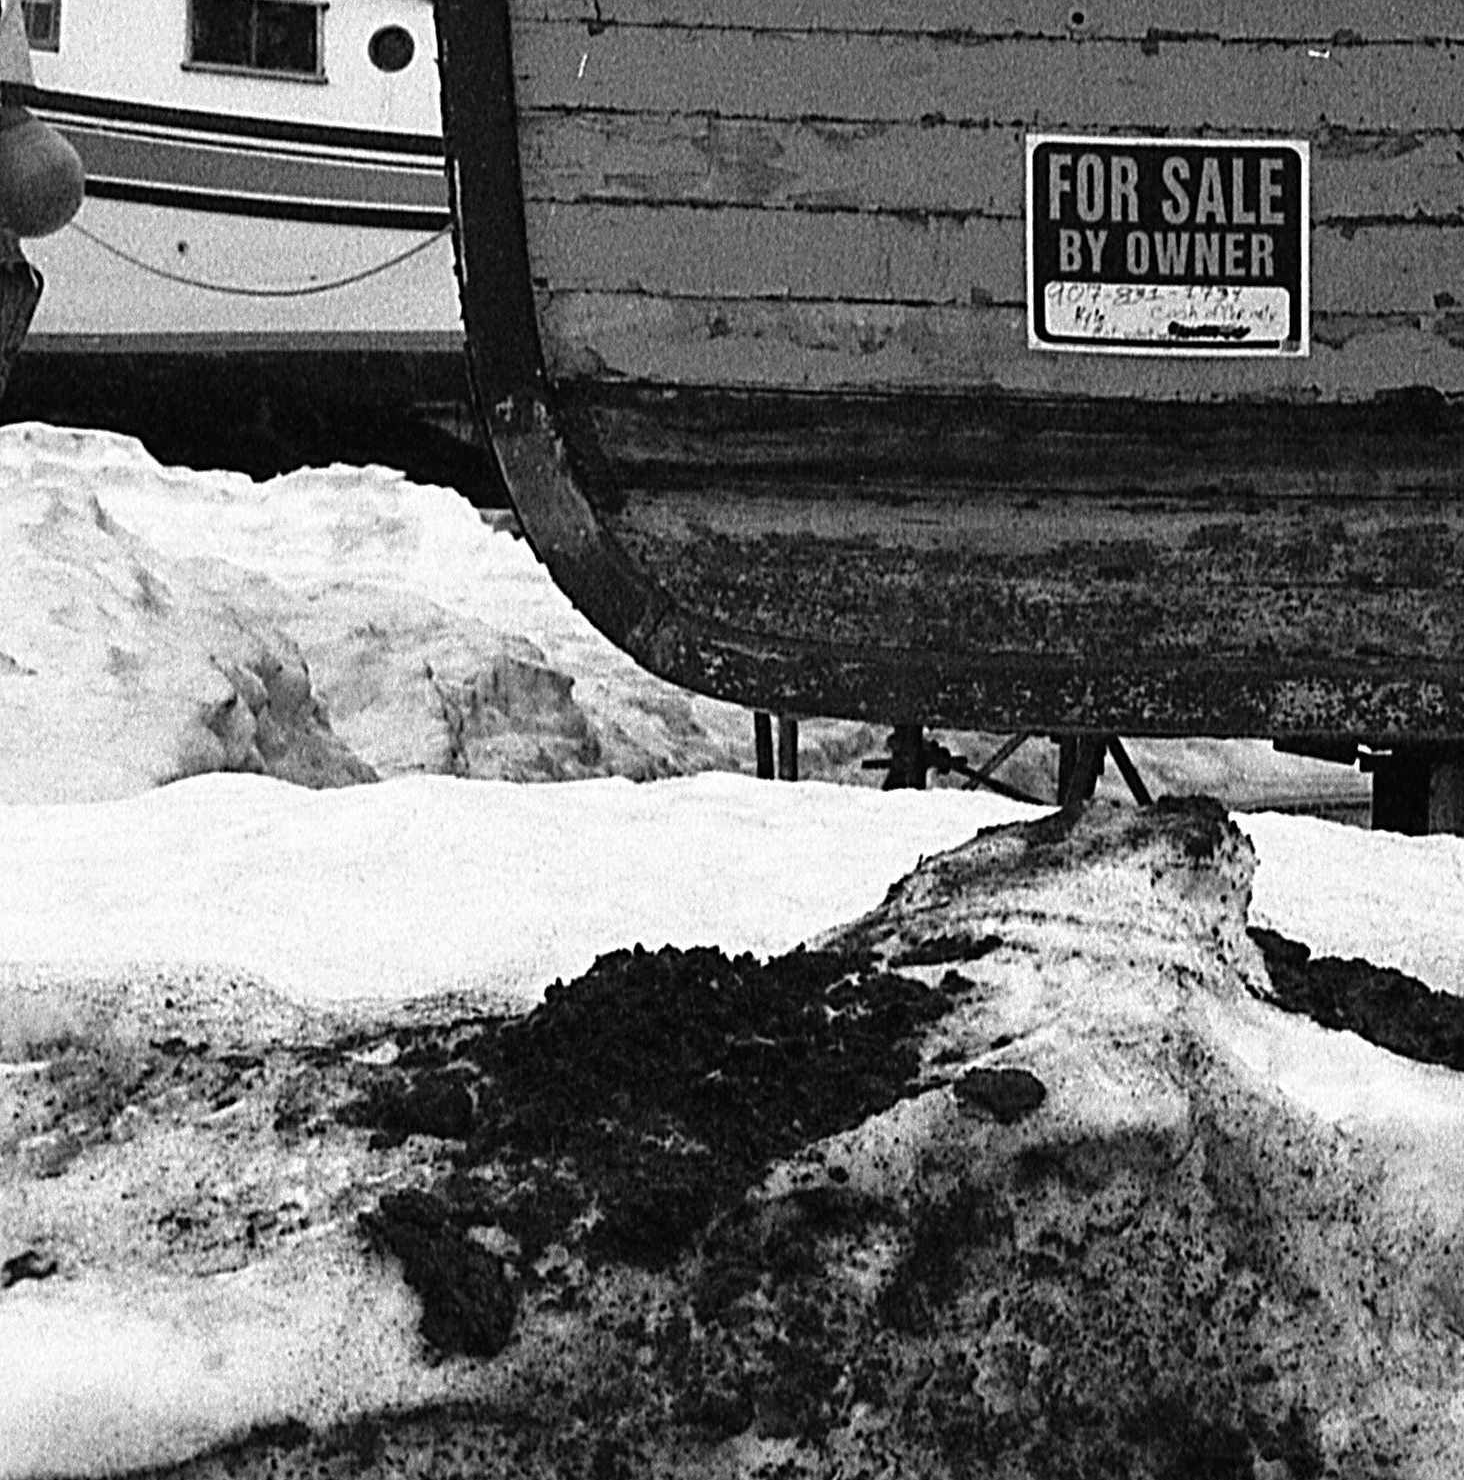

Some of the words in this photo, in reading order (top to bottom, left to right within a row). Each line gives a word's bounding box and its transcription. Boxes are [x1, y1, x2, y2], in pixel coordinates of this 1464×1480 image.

[1049, 153, 1139, 223] FOR
[1162, 156, 1285, 225] SALE
[1059, 228, 1108, 274] BY
[1126, 230, 1274, 277] OWNER
